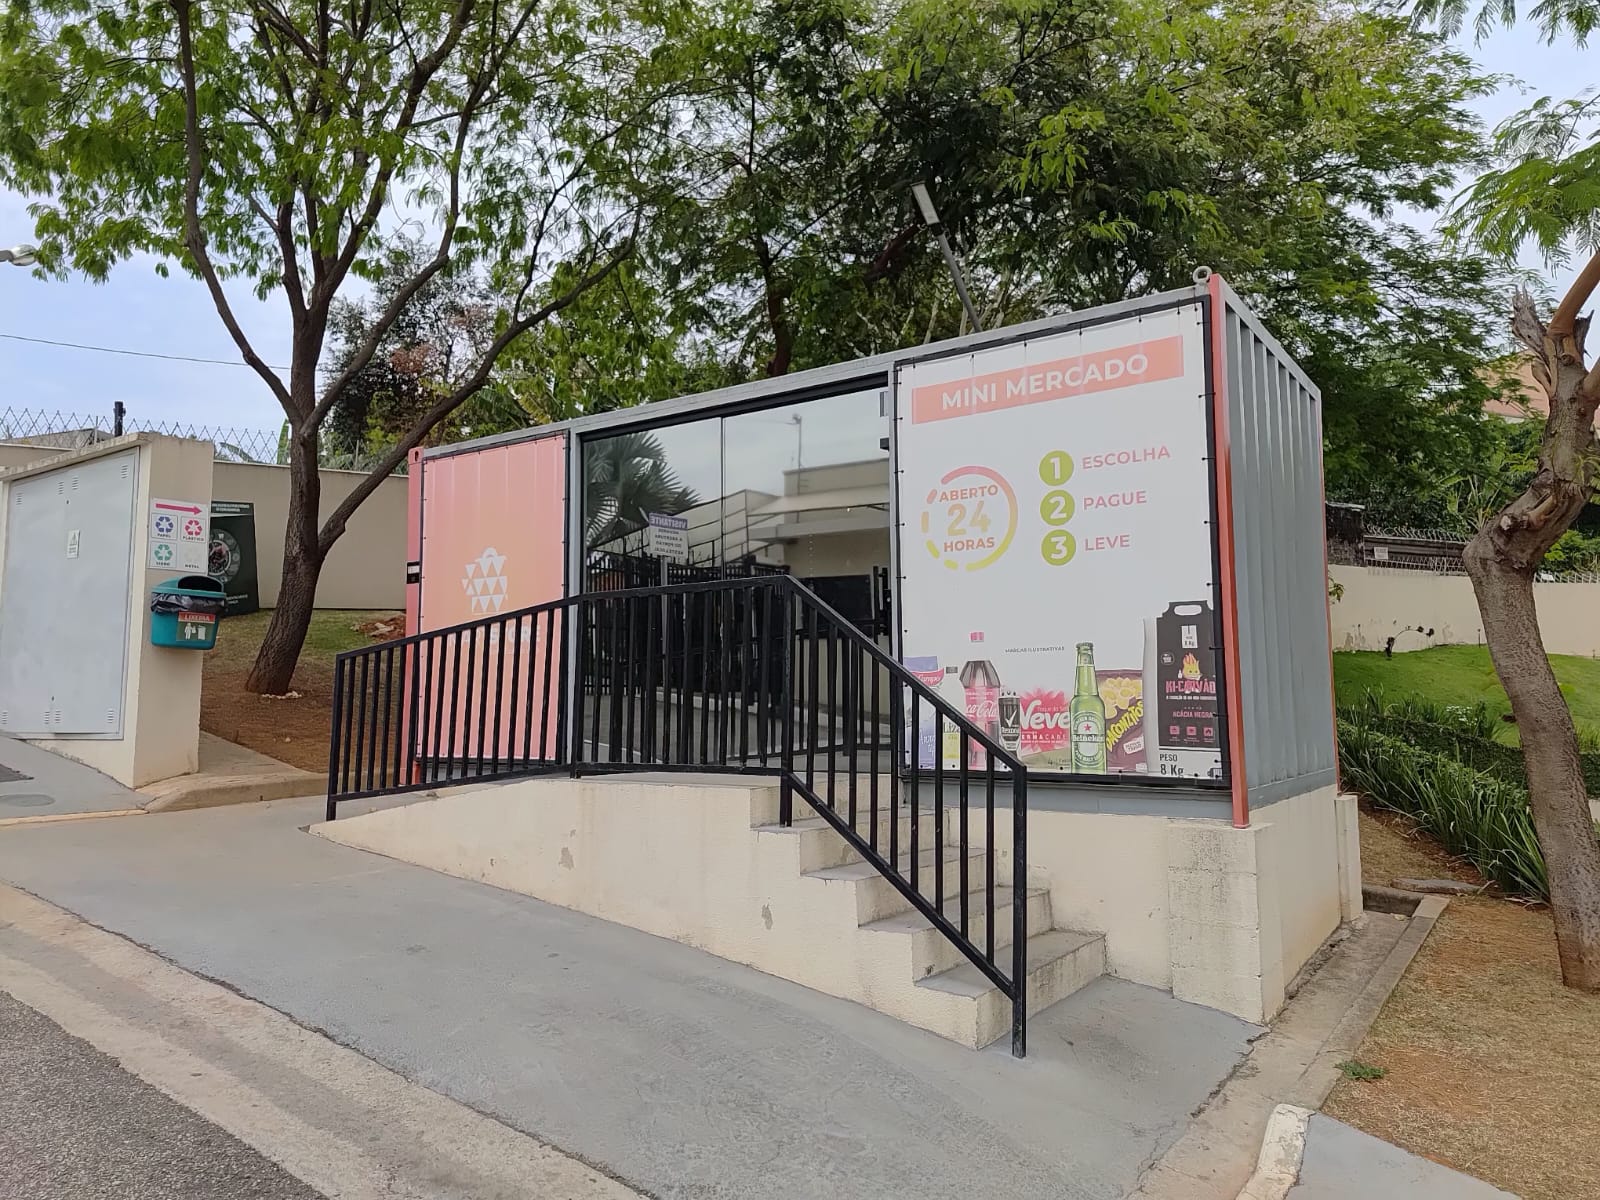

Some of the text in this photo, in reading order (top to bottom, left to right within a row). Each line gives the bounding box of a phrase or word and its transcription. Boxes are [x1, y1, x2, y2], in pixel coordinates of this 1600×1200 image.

[941, 353, 1149, 411] MINI MERCADO
[1049, 445, 1171, 480] 1 ESCOLHA
[939, 484, 999, 504] ABERTO
[1048, 490, 1148, 520] 2 PAGUE
[947, 501, 992, 537] 24
[943, 536, 996, 553] HORAS
[1050, 534, 1131, 559] 3 LEVE
[1072, 734, 1105, 742] Heineken
[1159, 753, 1178, 762] PESO
[1160, 763, 1184, 779] 8 Kg
